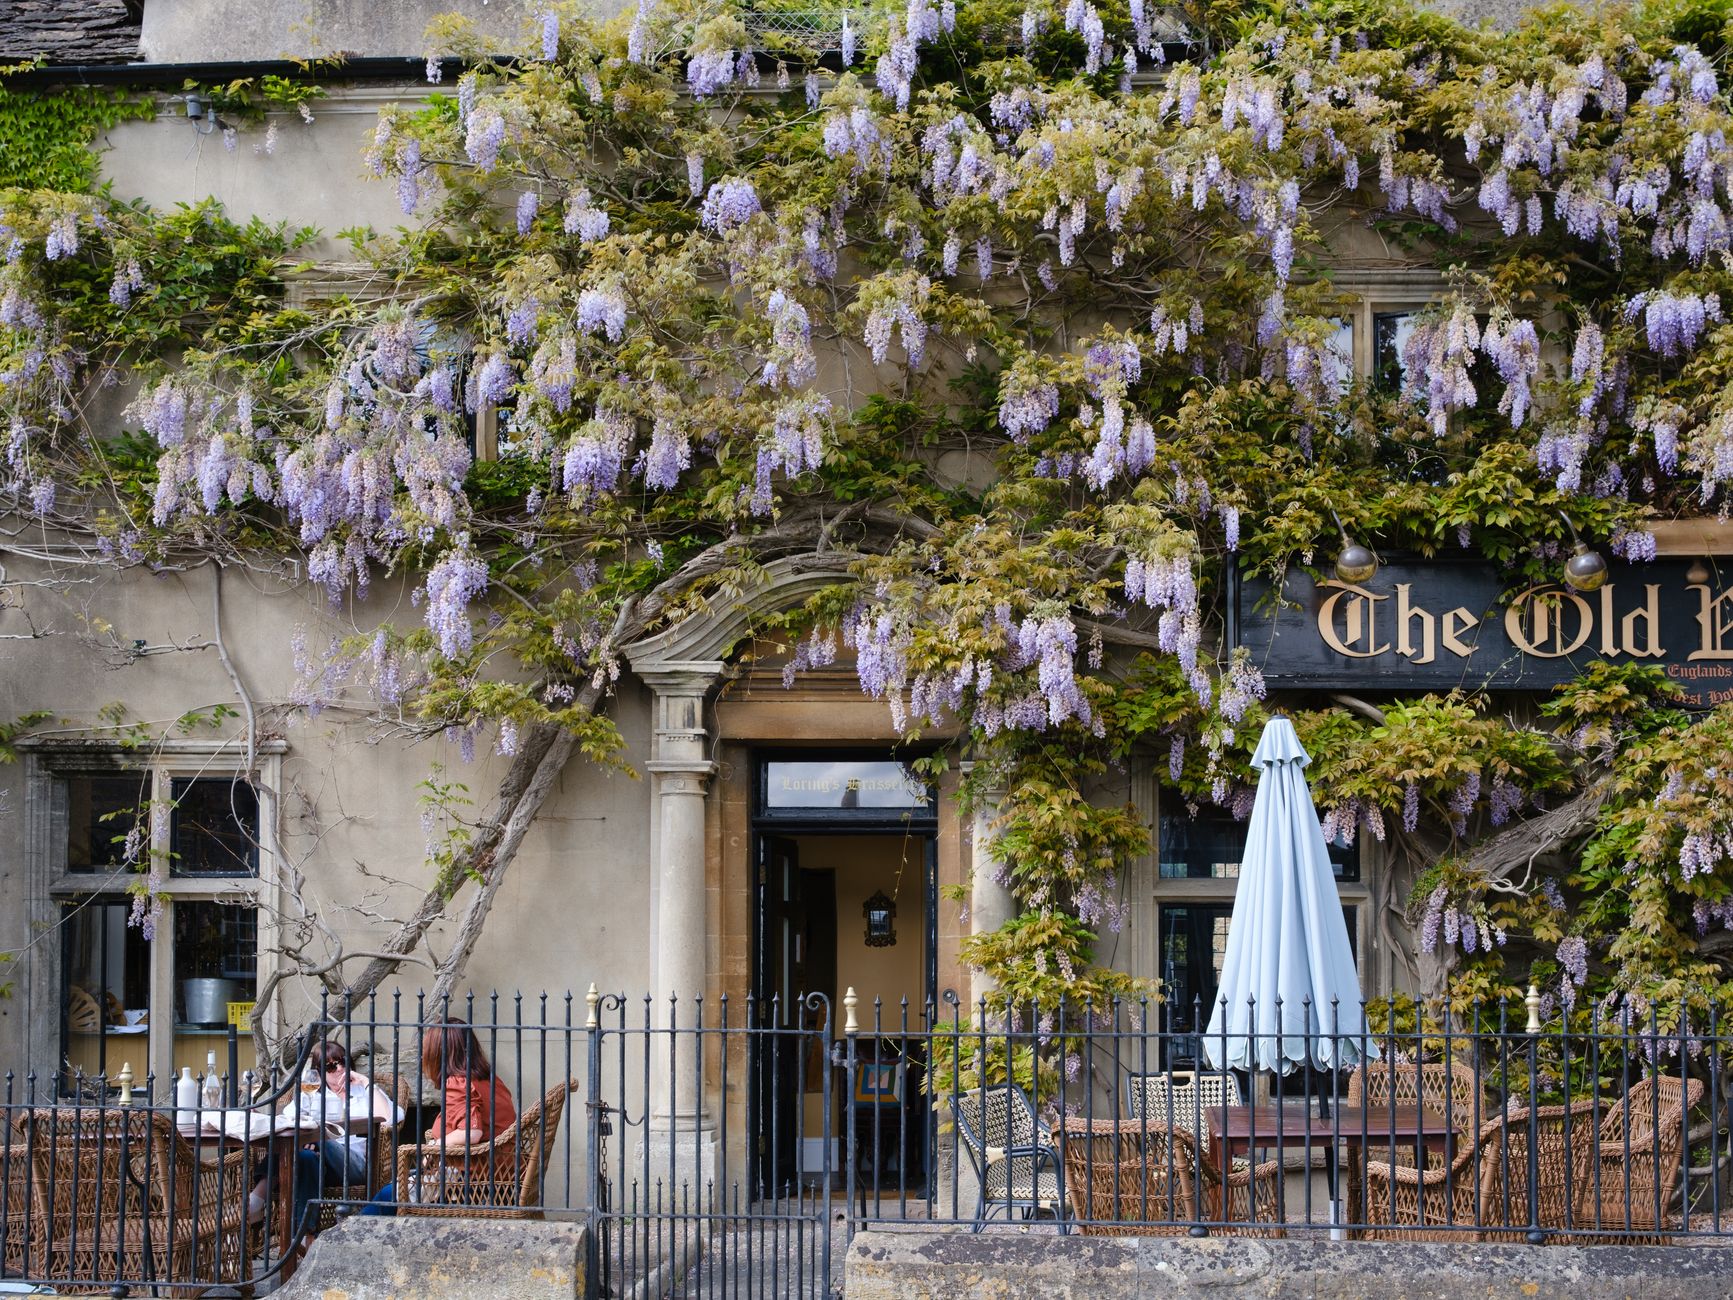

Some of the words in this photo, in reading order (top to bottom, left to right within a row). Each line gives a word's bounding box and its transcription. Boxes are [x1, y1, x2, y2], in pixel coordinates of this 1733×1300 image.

[1315, 579, 1480, 664] The
[1504, 583, 1668, 659] Old
[1667, 663, 1733, 680] Englands
[782, 775, 841, 792] Loring's
[846, 775, 916, 792] Brasse
